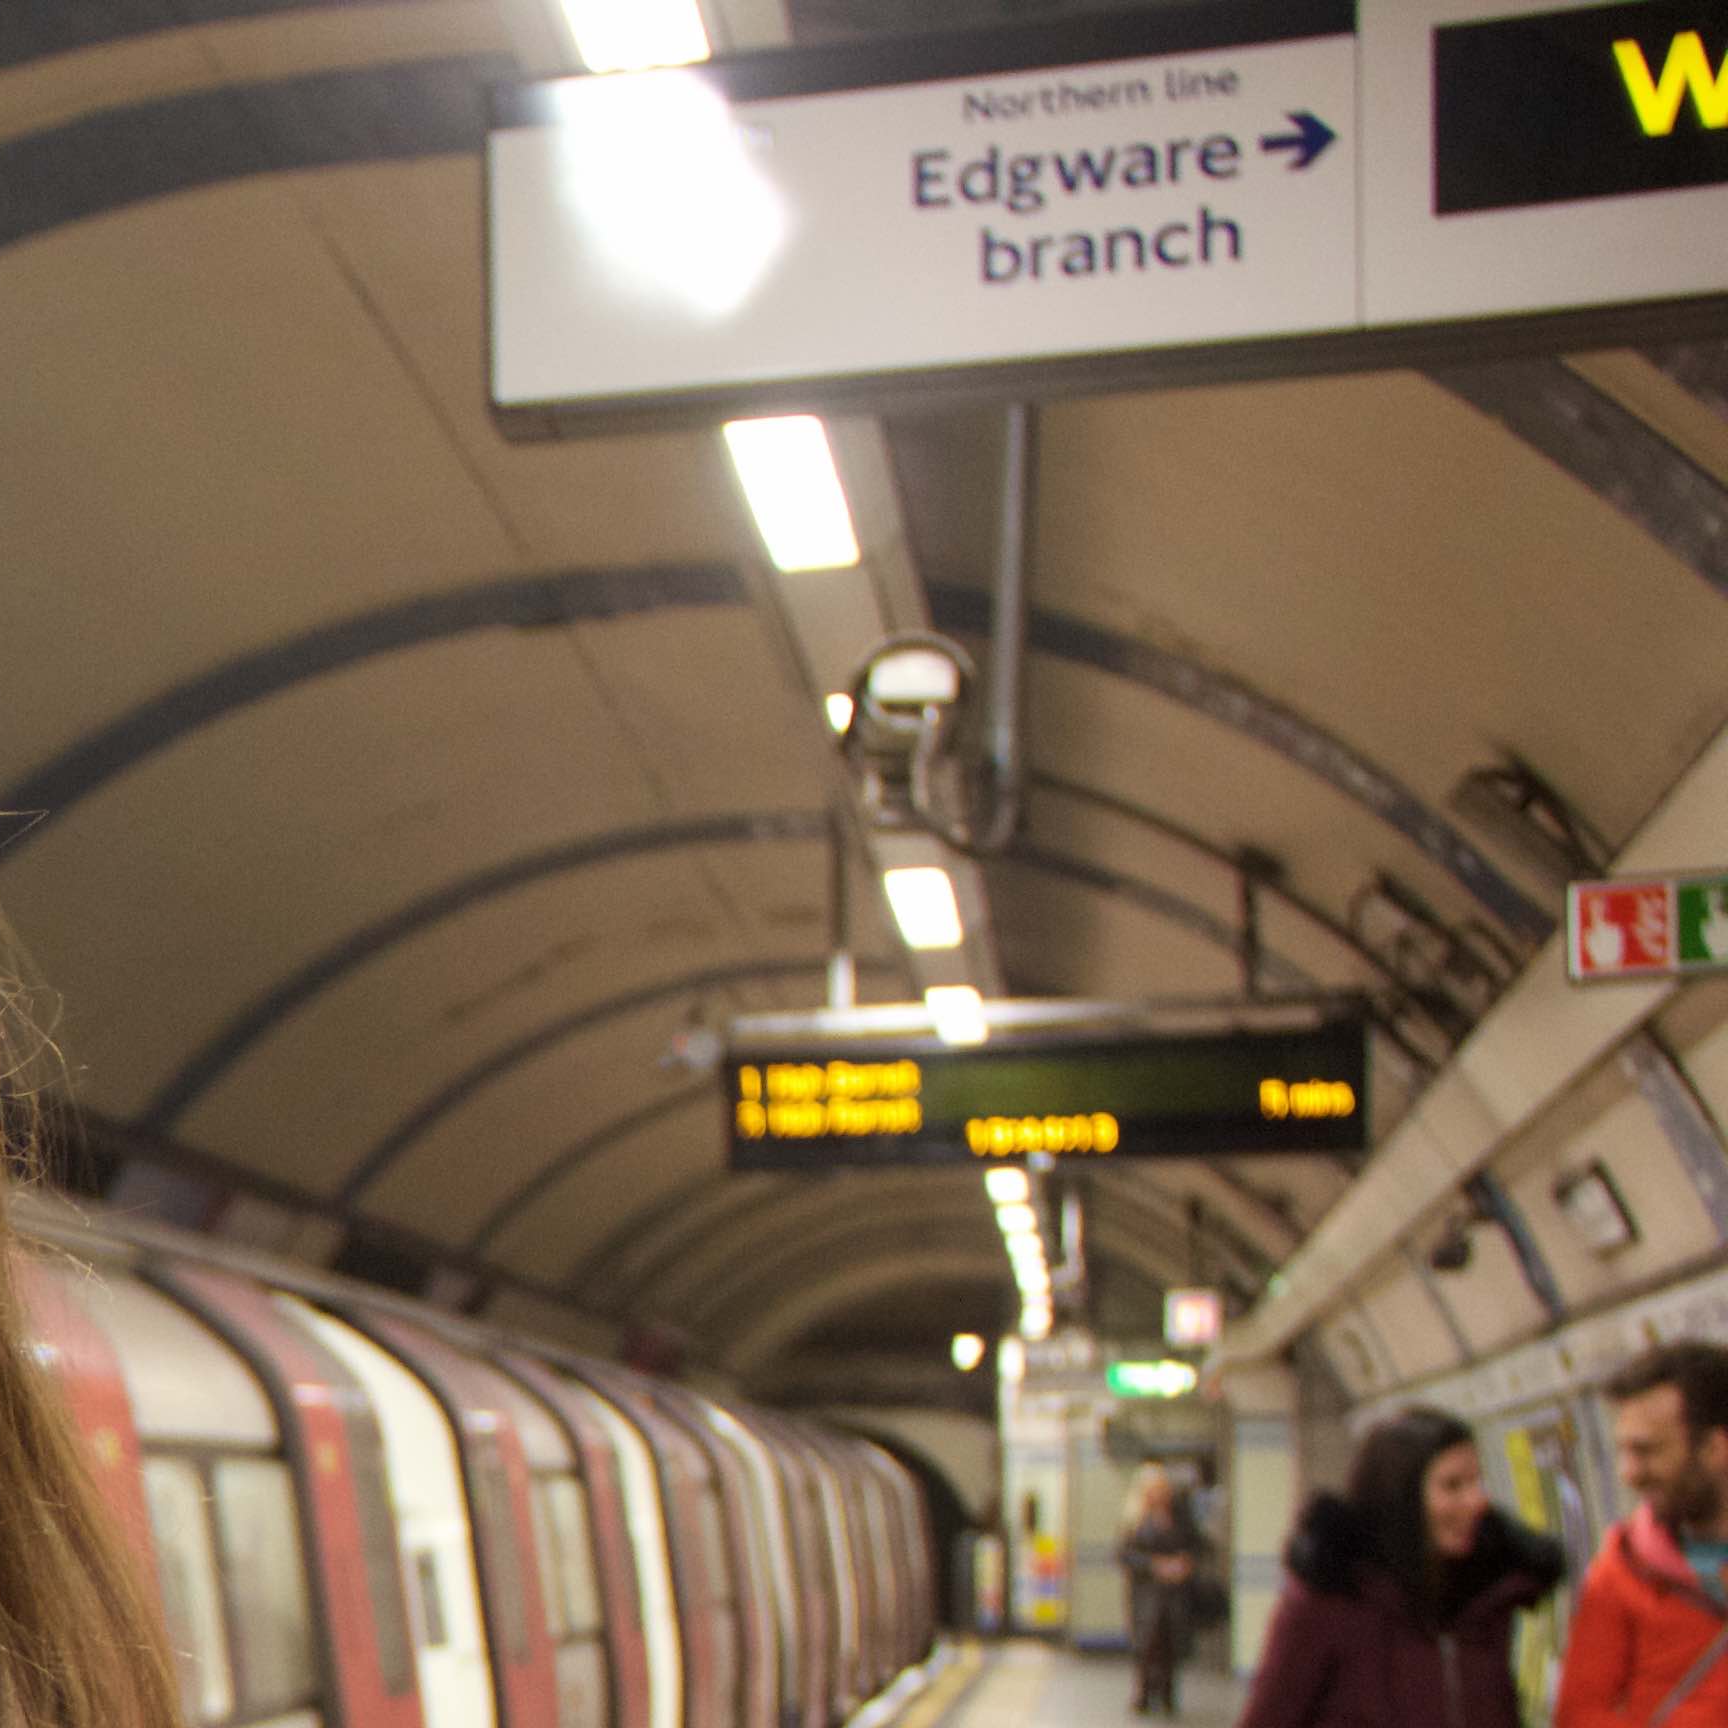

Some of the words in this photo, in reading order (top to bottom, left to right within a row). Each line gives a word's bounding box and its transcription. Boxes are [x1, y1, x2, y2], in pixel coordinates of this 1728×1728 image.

[962, 79, 1151, 122] Northern
[1164, 68, 1239, 102] line
[911, 133, 1241, 214] Edgware
[981, 204, 1242, 284] branch
